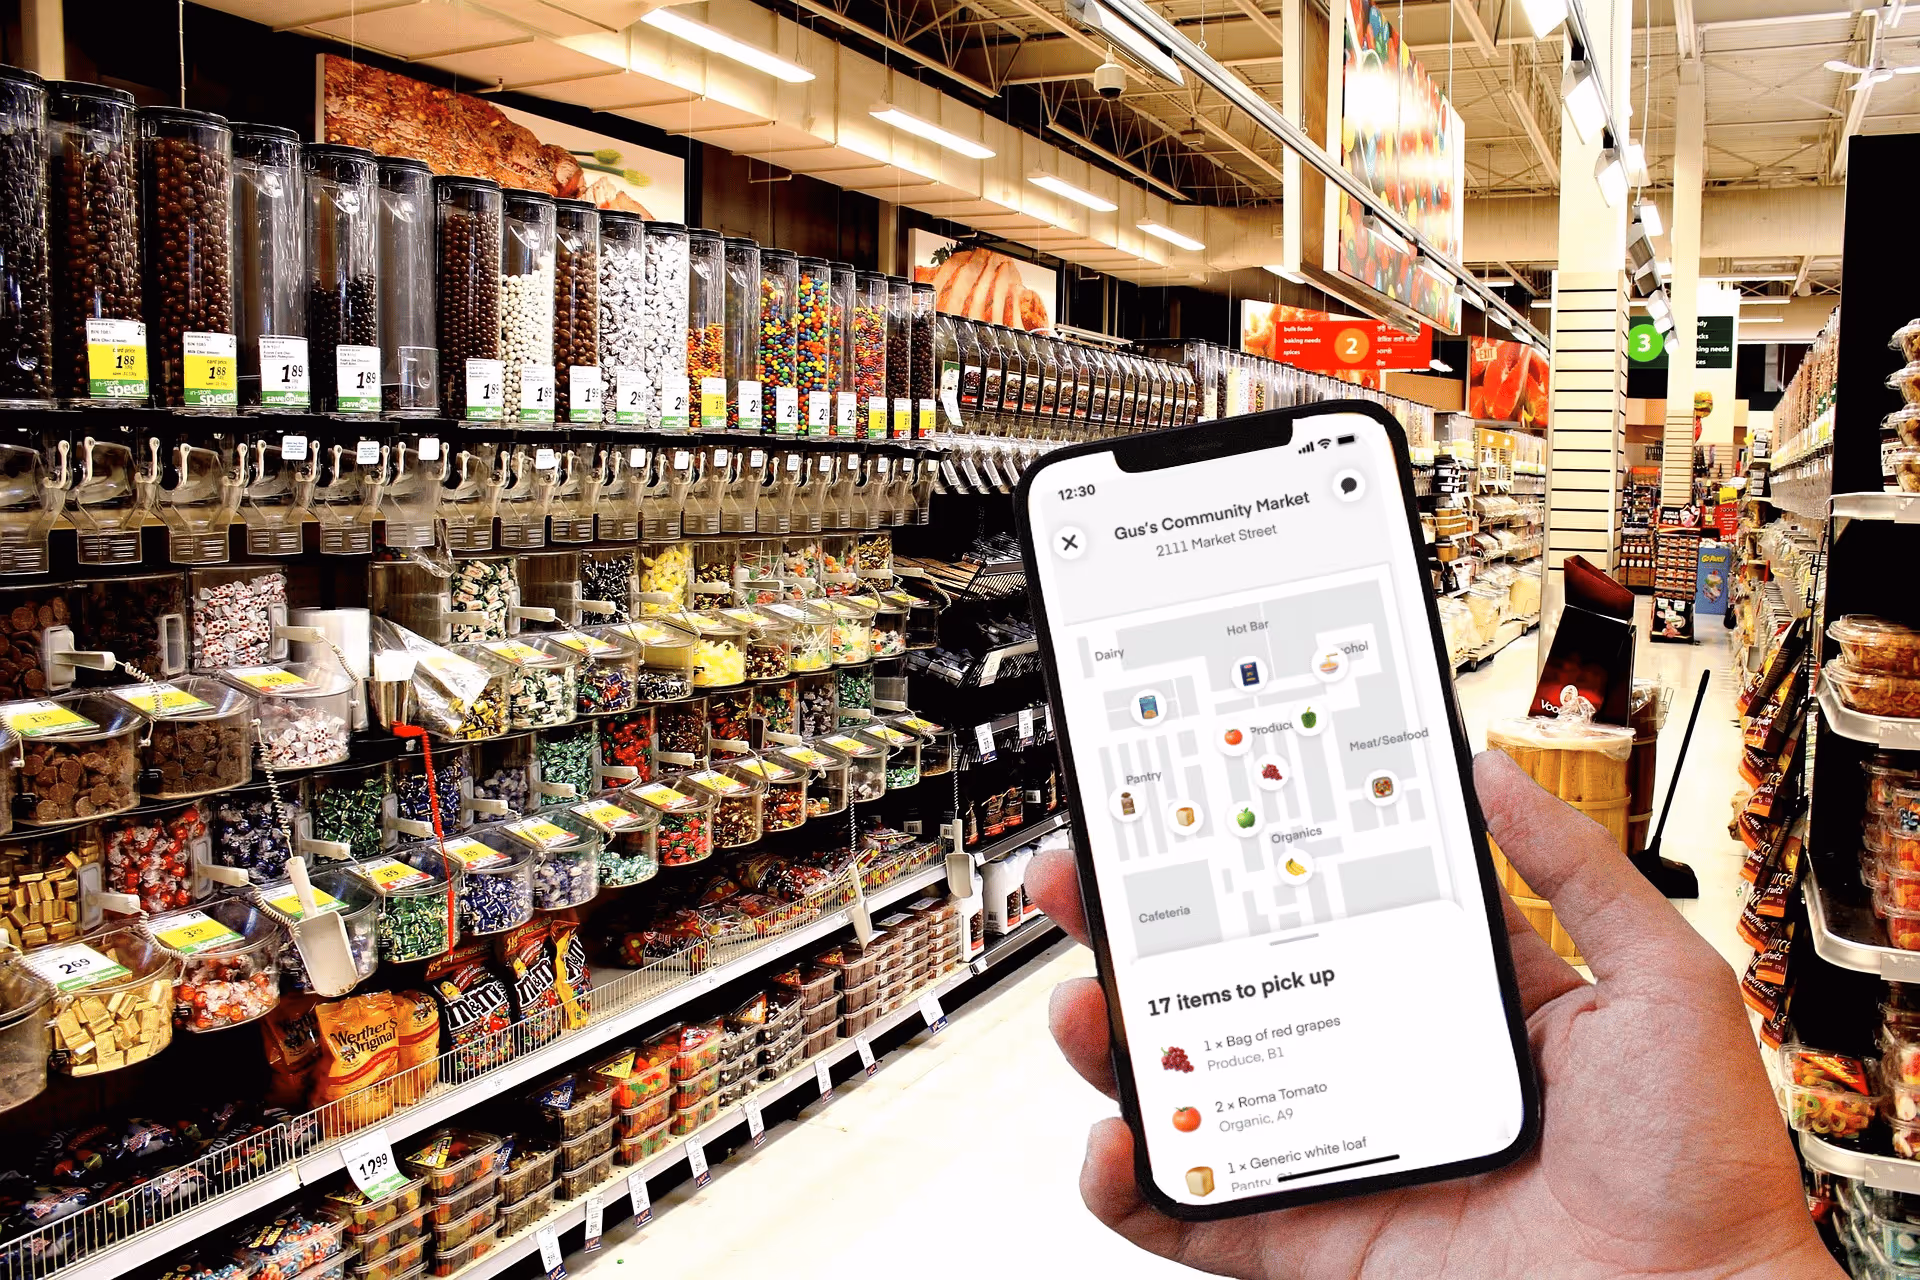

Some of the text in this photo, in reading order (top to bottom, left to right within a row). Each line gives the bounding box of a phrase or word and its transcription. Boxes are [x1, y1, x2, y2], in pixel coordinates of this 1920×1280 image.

[1345, 338, 1358, 354] 2
[1638, 334, 1651, 352] 3
[1480, 350, 1493, 359] EXIT
[106, 383, 146, 398] special
[200, 392, 236, 405] special
[1057, 484, 1096, 501] 12:30
[1114, 492, 1310, 541] Gus's Community Market
[1156, 524, 1278, 558] 2111 Market Street
[1226, 620, 1269, 636] Hot Bar
[1094, 648, 1125, 663] Dairy
[1350, 728, 1429, 752] Meat/Seafood
[1126, 770, 1162, 786] Pantry
[1271, 826, 1322, 844] Organics
[391, 873, 424, 890] sale
[1138, 905, 1191, 924] Cafeteria
[58, 958, 91, 974] 269
[1148, 968, 1336, 1016] 17 items to pick up
[330, 1016, 398, 1046] Werther's
[1204, 1040, 1212, 1052] 1
[1226, 1034, 1253, 1048] Bag
[1255, 1028, 1268, 1042] of
[1272, 1024, 1292, 1038] red
[1296, 1016, 1341, 1036] grapes
[352, 1027, 396, 1054] Original
[1208, 1046, 1284, 1072] Produce, B1
[1215, 1101, 1224, 1112] 2
[1238, 1093, 1276, 1108] Roma
[1278, 1083, 1328, 1100] Tomato
[1218, 1108, 1294, 1132] Organic, A9
[1228, 1162, 1236, 1174] 1
[1250, 1150, 1302, 1170] Generic
[1304, 1144, 1340, 1160] white
[1342, 1136, 1368, 1152] loaf
